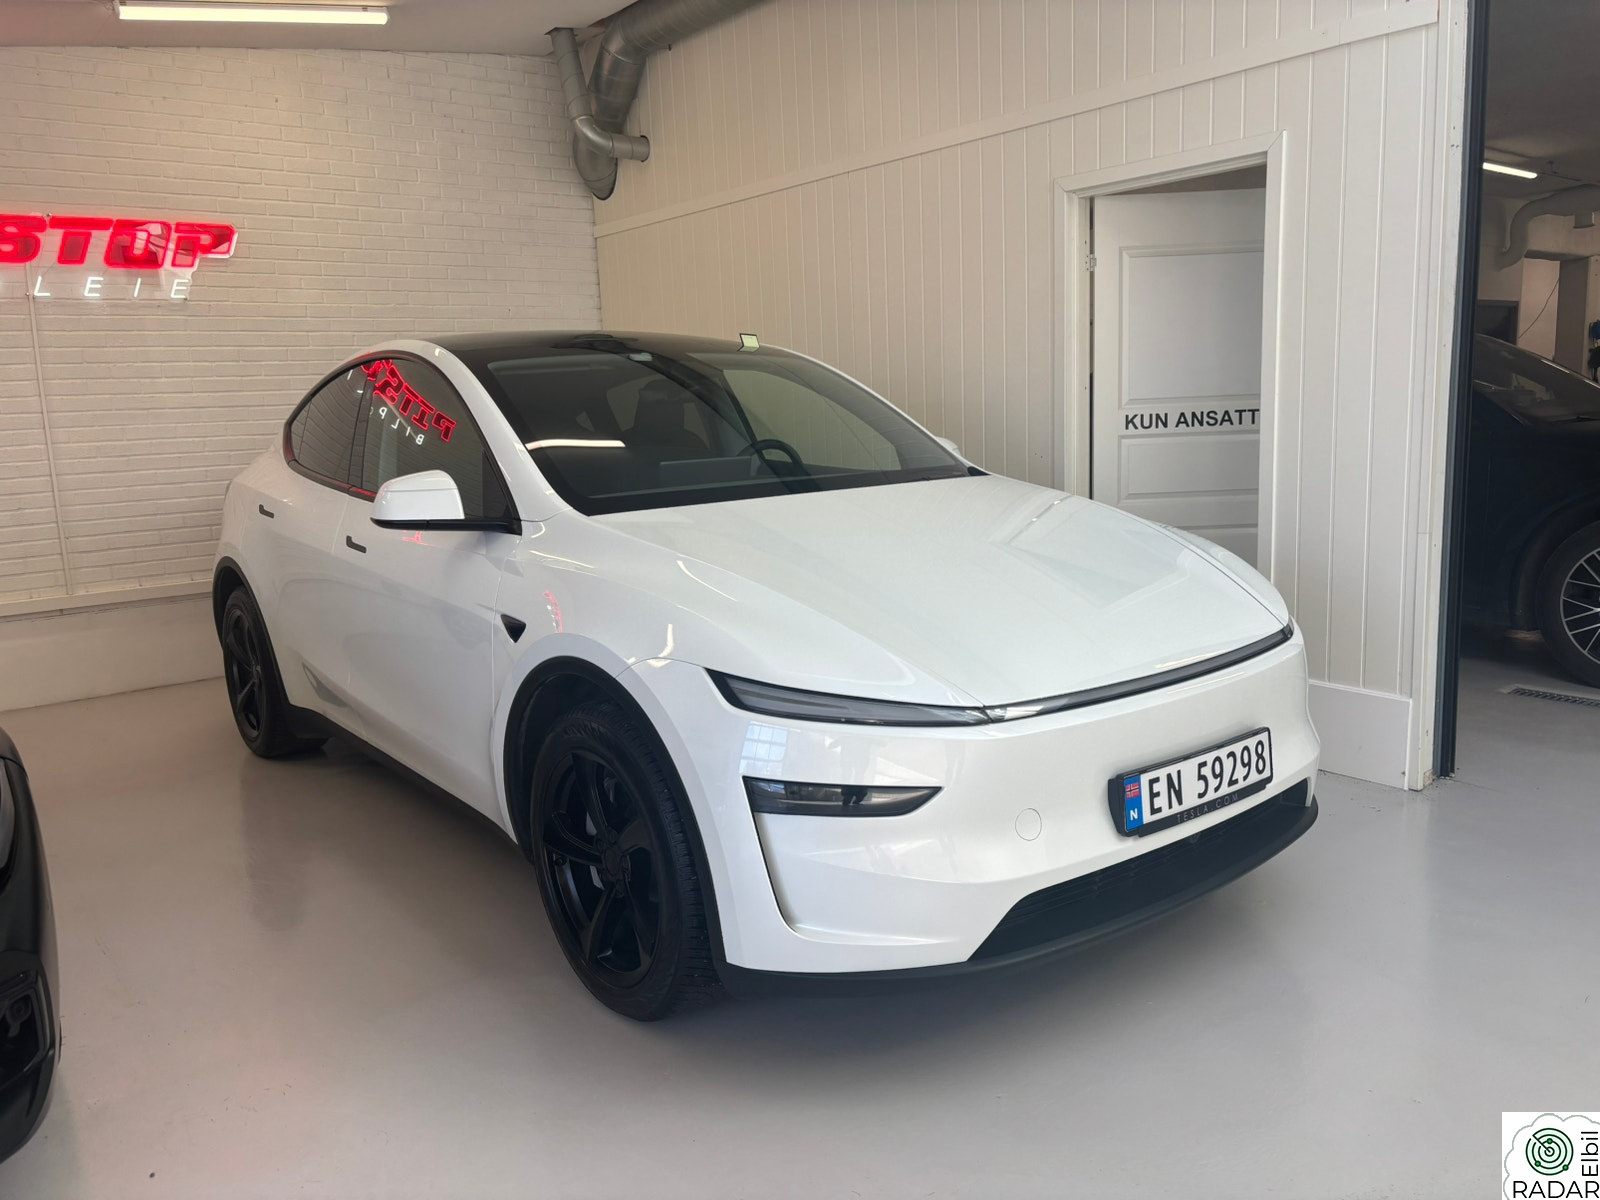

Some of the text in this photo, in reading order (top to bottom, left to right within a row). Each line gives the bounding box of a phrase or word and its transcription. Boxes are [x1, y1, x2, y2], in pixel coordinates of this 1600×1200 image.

[1125, 408, 1260, 430] KUN ANSATT
[1148, 739, 1267, 816] EN 59298
[1130, 808, 1139, 821] N
[1177, 793, 1239, 823] TESLA.COM
